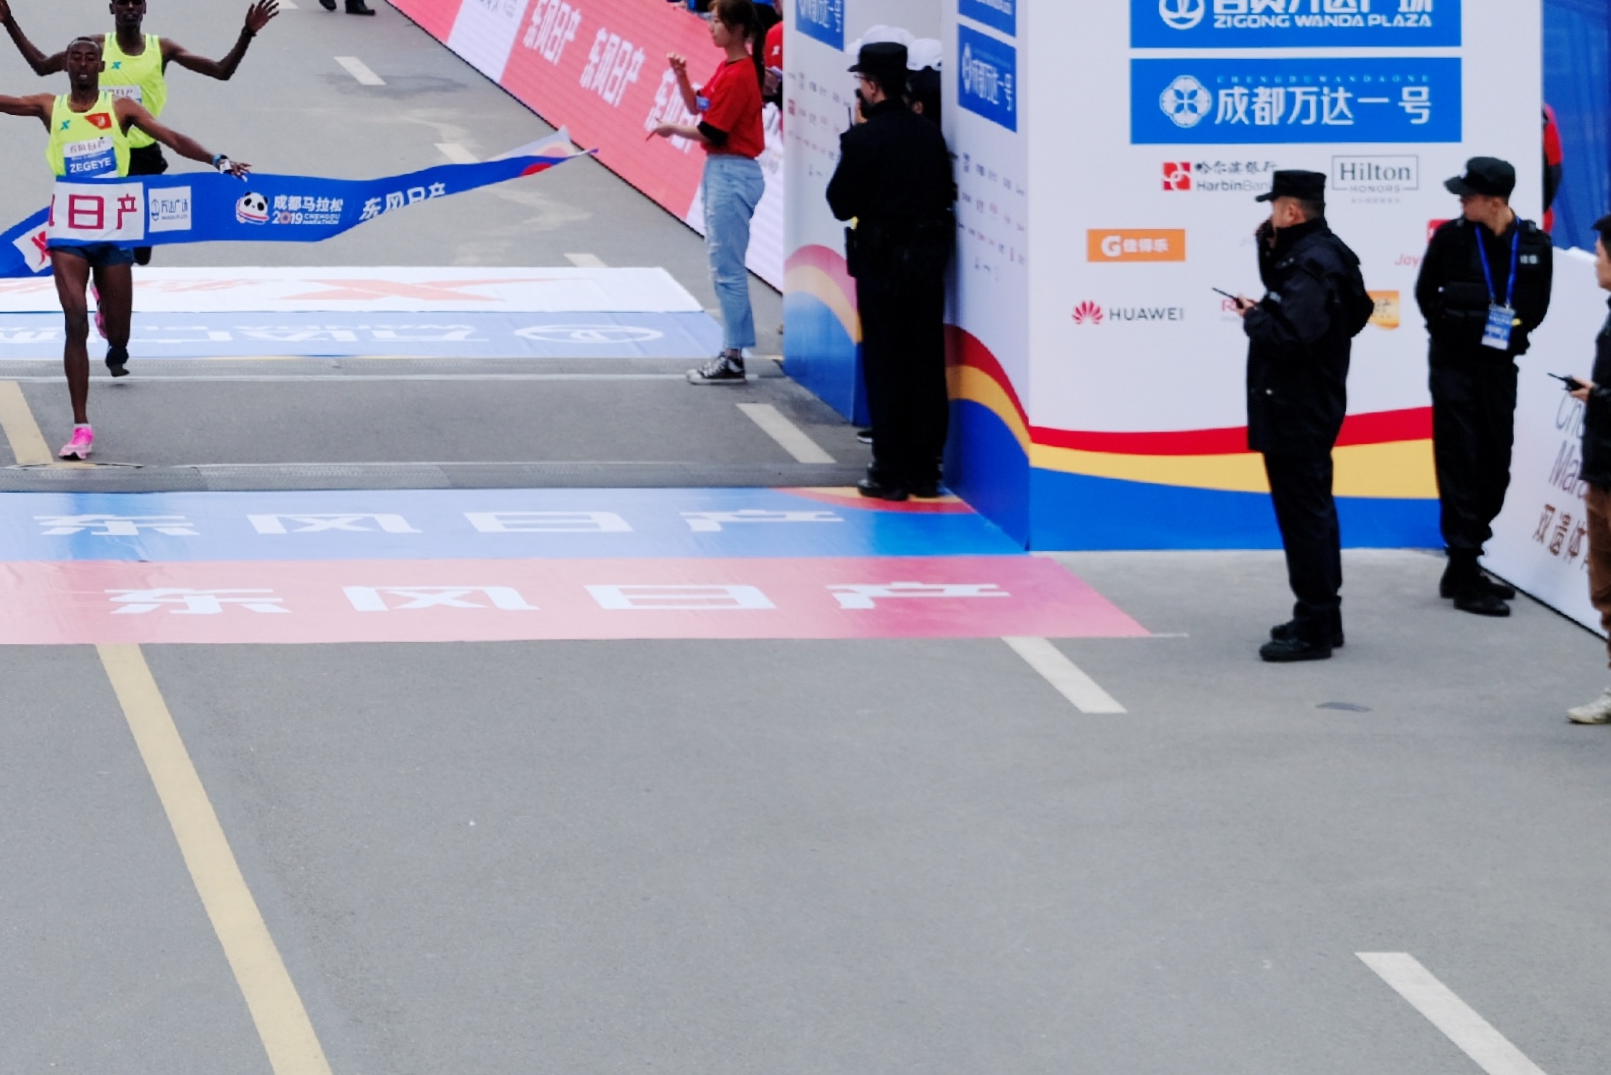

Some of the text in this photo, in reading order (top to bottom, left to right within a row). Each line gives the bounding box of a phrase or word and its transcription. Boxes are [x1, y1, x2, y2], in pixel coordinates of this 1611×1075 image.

[1213, 14, 1432, 29] ZIGONG WANDA PLAZA
[1215, 86, 1432, 127] 成都万达一号
[70, 157, 112, 174] ZEGEYE
[1340, 162, 1412, 182] Hilton
[1349, 185, 1402, 193] HONORS
[273, 195, 344, 213] 成都马拉松
[358, 182, 447, 222] 东风日产
[1109, 306, 1185, 322] HUAWEI
[32, 510, 845, 537] 东风日产
[103, 580, 1012, 615] 东风日产
